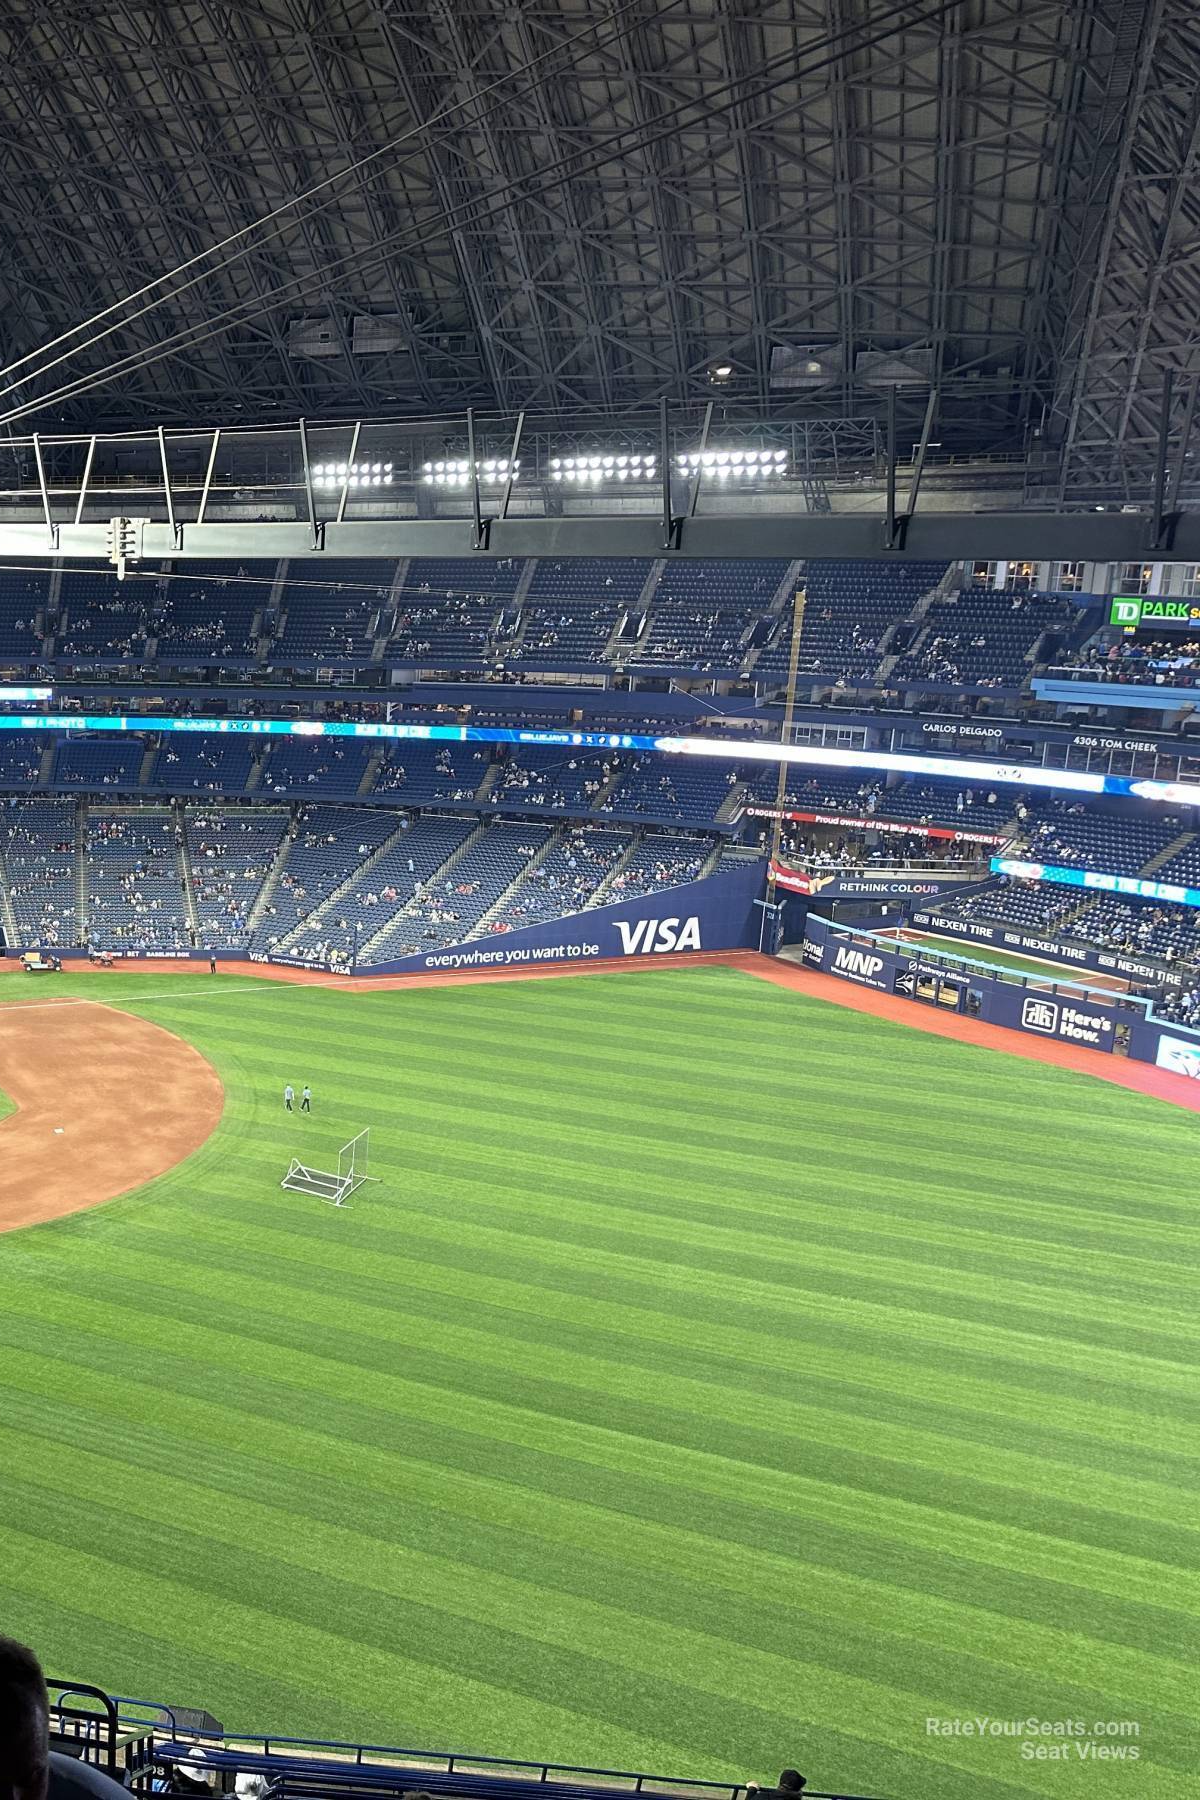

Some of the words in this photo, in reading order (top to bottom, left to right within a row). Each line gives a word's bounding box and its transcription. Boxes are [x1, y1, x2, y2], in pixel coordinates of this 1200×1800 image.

[1114, 602, 1138, 620] TD
[1143, 601, 1190, 617] PARK
[922, 723, 957, 734] CARLOS
[960, 726, 1002, 737] DELGADO
[1073, 736, 1098, 747] 4306
[1100, 738, 1123, 749] TOM
[1125, 740, 1158, 752] CHEEK
[755, 808, 781, 818] ROGERS
[815, 815, 839, 825] Proud
[840, 818, 866, 828] owner
[866, 820, 875, 829] of
[875, 822, 889, 831] the
[890, 824, 908, 833] Blue
[909, 826, 929, 836] Jays
[964, 833, 994, 843] ROGERS
[839, 882, 888, 892] RETHINK
[890, 883, 939, 894] COLOUR
[612, 916, 701, 955] VISA
[931, 917, 967, 932] NEXEN
[968, 924, 994, 938] TIRE
[248, 951, 269, 963] VISA
[425, 949, 504, 968] everywhere
[505, 948, 531, 964] you
[531, 944, 566, 961] want
[566, 943, 582, 957] to
[582, 942, 599, 956] be
[1022, 937, 1059, 954] NEXEN
[1060, 946, 1087, 960] TIRE
[329, 963, 351, 975] VISA
[835, 946, 884, 977] MNP
[918, 964, 946, 978] Pathways
[946, 971, 971, 984] Alliance
[1117, 960, 1155, 978] NEXEN
[1156, 970, 1182, 985] TIRE
[1061, 1007, 1112, 1032] Here's
[1060, 1022, 1100, 1043] How.
